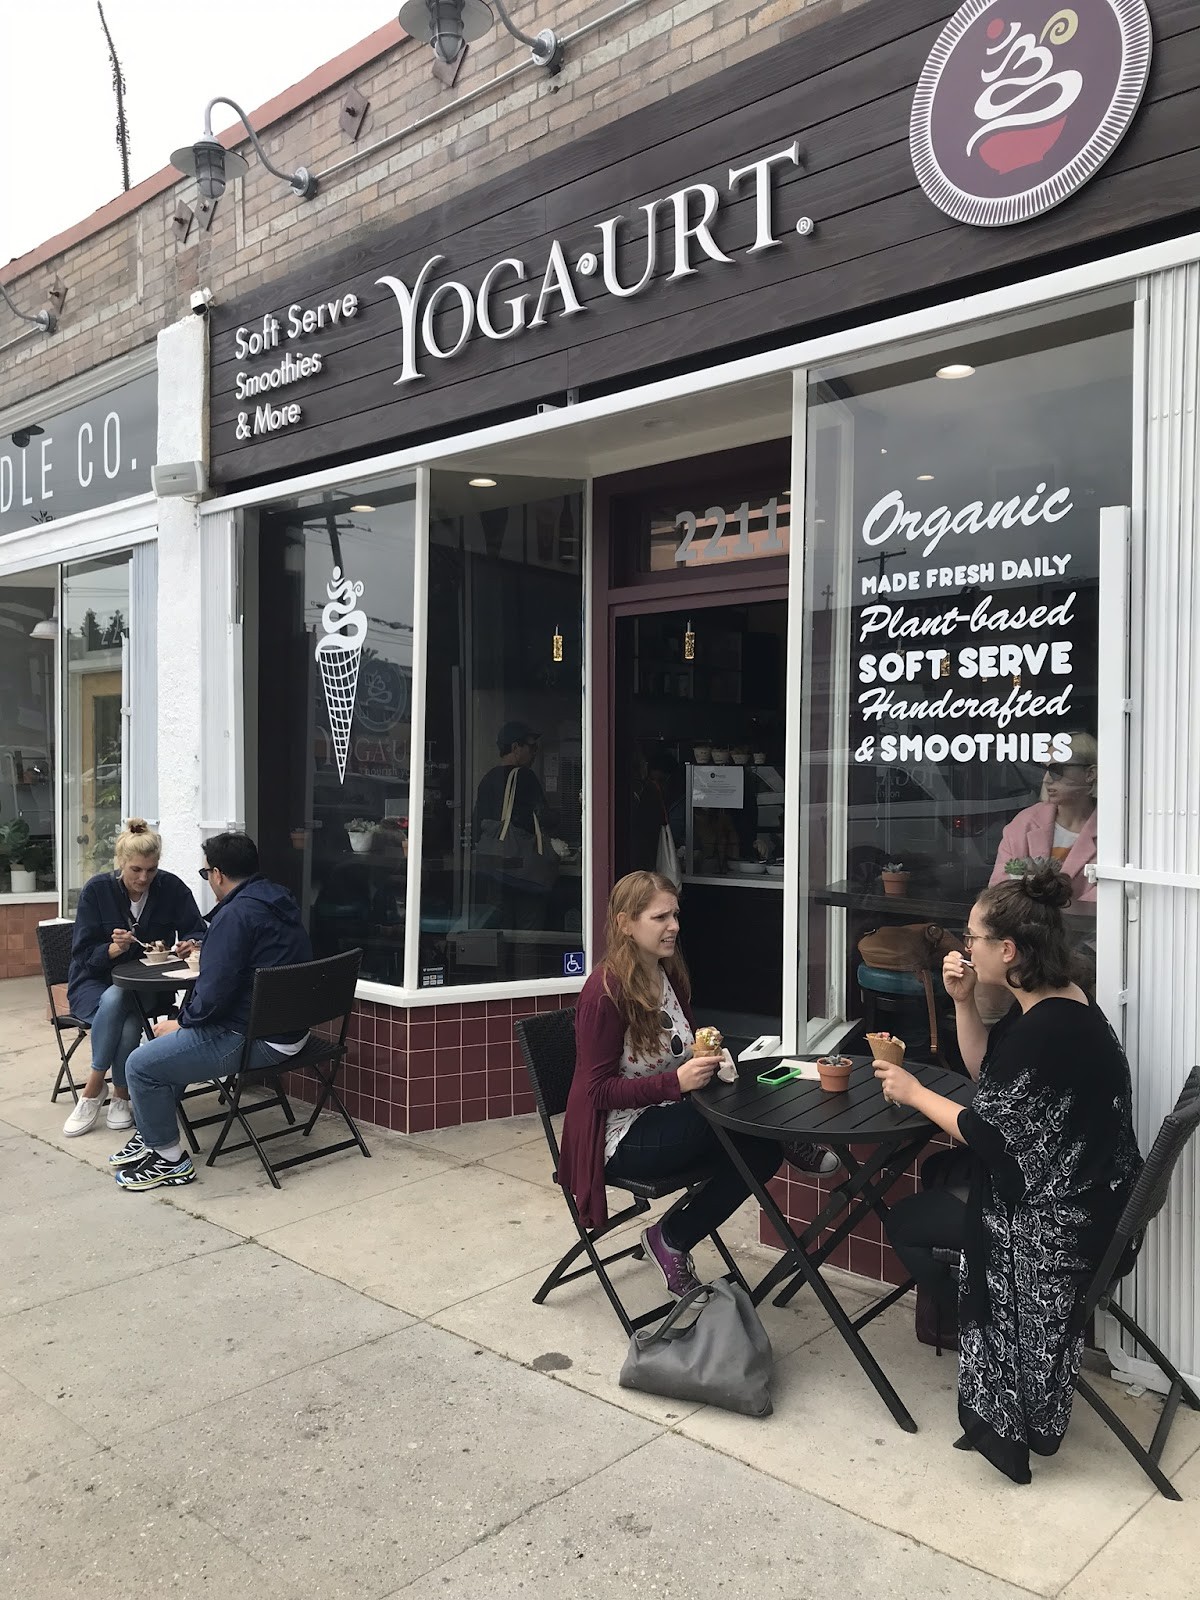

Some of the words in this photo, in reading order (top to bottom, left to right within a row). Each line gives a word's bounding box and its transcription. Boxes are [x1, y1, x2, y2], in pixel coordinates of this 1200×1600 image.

[235, 313, 282, 360] Soft
[287, 293, 359, 339] Serve
[235, 352, 323, 400] Smoothies
[235, 411, 252, 440] &
[253, 403, 302, 436] More
[0, 437, 54, 513] DLE
[77, 411, 137, 488] CO.
[674, 497, 784, 562] 2211
[862, 482, 1074, 558] Organic
[861, 571, 921, 595] MADE
[926, 563, 995, 592] FRESH
[1001, 553, 1073, 581] DAILY
[859, 591, 1077, 643] Plant-based
[858, 649, 948, 684] SOFT
[958, 641, 1073, 679] SERVE
[857, 683, 1074, 729] Handcrafted
[854, 735, 875, 763] &
[880, 732, 1073, 763] SMOOTHIES
